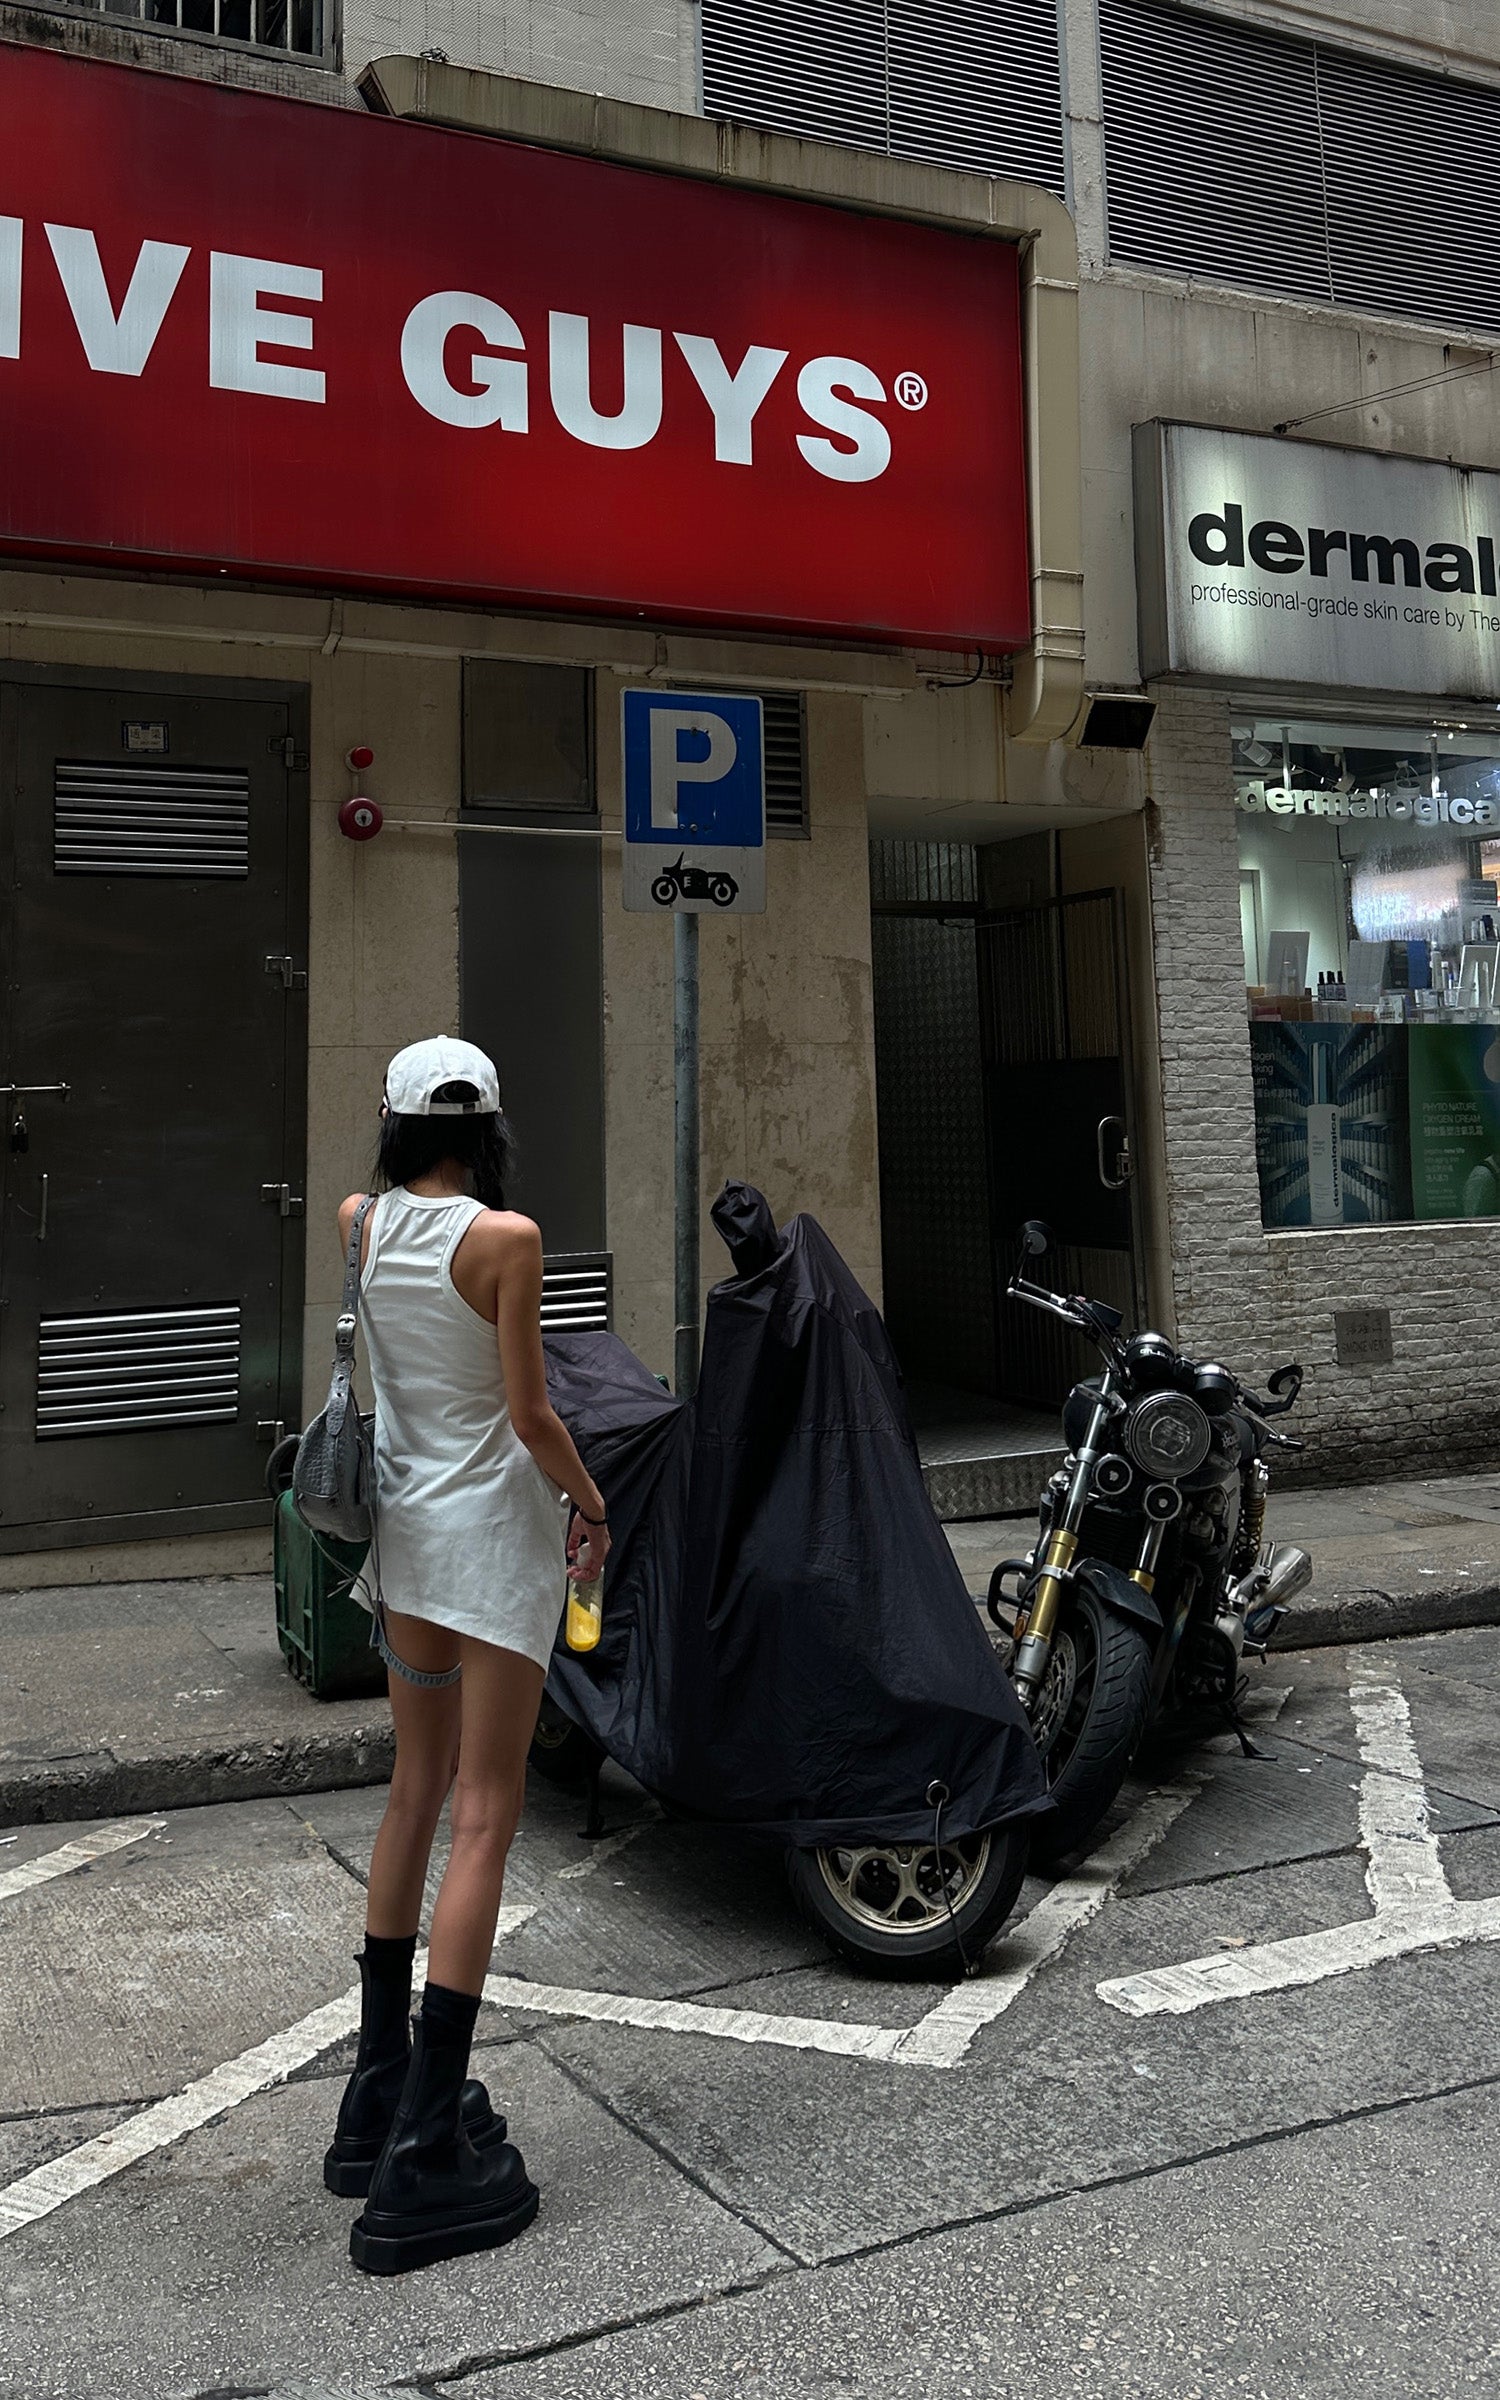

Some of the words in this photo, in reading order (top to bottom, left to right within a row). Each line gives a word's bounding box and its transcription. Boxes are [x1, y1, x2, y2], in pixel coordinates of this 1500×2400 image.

[1188, 502, 1500, 597] dermal
[1190, 582, 1359, 618] professional-grade
[1363, 600, 1398, 621] skin
[1403, 607, 1440, 626] care
[1445, 607, 1466, 632] by
[1470, 609, 1500, 632] The
[650, 708, 738, 829] P
[1235, 780, 1499, 827] dermalogica
[1448, 1102, 1479, 1112] NATURE
[1330, 1112, 1340, 1208] dermalogica
